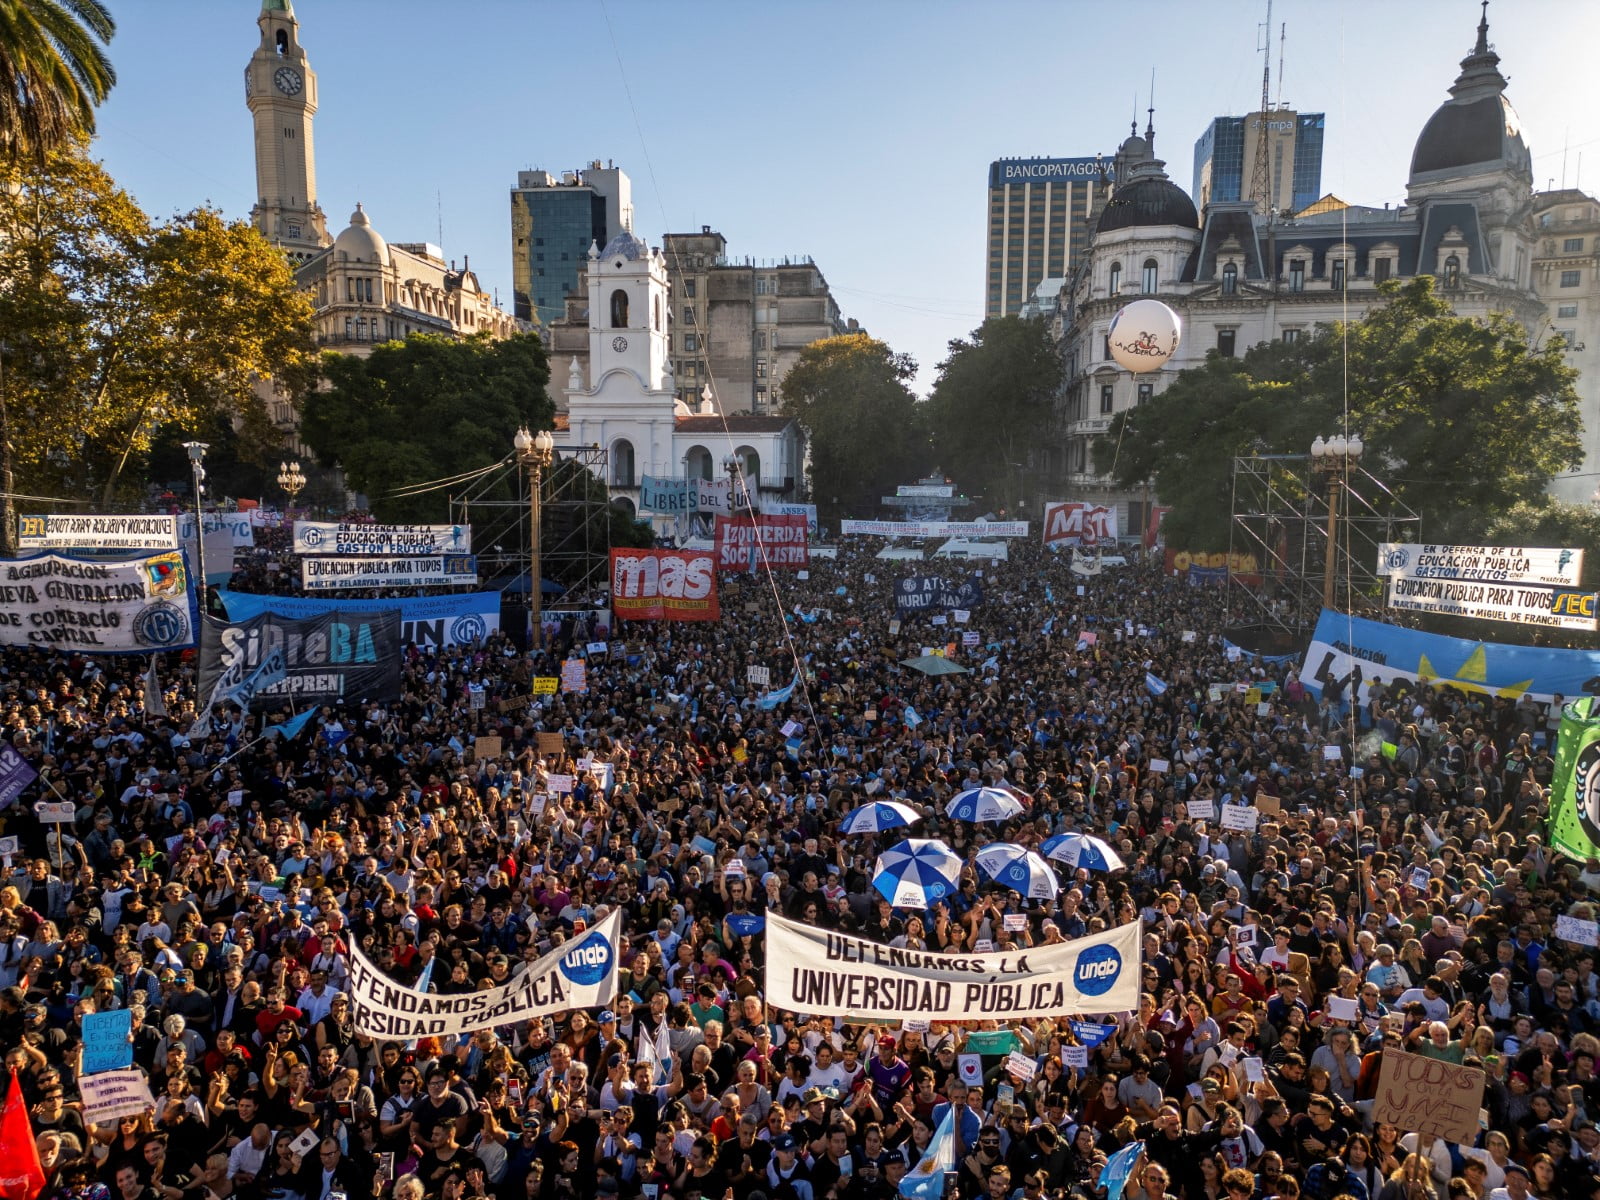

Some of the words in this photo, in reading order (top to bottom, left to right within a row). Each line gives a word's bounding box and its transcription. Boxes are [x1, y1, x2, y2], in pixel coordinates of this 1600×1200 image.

[643, 487, 697, 508] LIBRES
[701, 495, 721, 507] DEL
[338, 524, 350, 532] EN
[356, 524, 398, 533] DEFENSA
[404, 525, 415, 533] DE
[420, 525, 431, 533] LA
[723, 523, 805, 543] IZQUIERDA
[1050, 508, 1104, 541] MST
[389, 544, 433, 554] FRUTOS
[1442, 546, 1485, 555] DEFENSA
[1492, 547, 1505, 556] DE
[1511, 547, 1522, 556] LA
[392, 560, 412, 574] PARA
[415, 559, 442, 573] TODOS
[445, 558, 473, 573] SEC
[1416, 566, 1457, 577] GASTON
[1463, 568, 1508, 579] FRUTOS
[414, 578, 423, 586] DE
[614, 555, 713, 599] mas
[1487, 587, 1514, 606] PARA
[1517, 590, 1552, 609] TODOS
[1552, 593, 1594, 616] SEC
[1424, 603, 1468, 614] ZELARAYAN
[1476, 608, 1507, 620] MIGUEL
[1511, 612, 1522, 622] DE
[257, 674, 338, 694] ATPREN
[564, 946, 608, 969] unab
[1001, 955, 1032, 974] LA
[1079, 960, 1118, 980] unab
[502, 974, 530, 1000] LA
[792, 968, 951, 1013] UNIVERSIDAD
[964, 976, 1064, 1012] PÚBLICA
